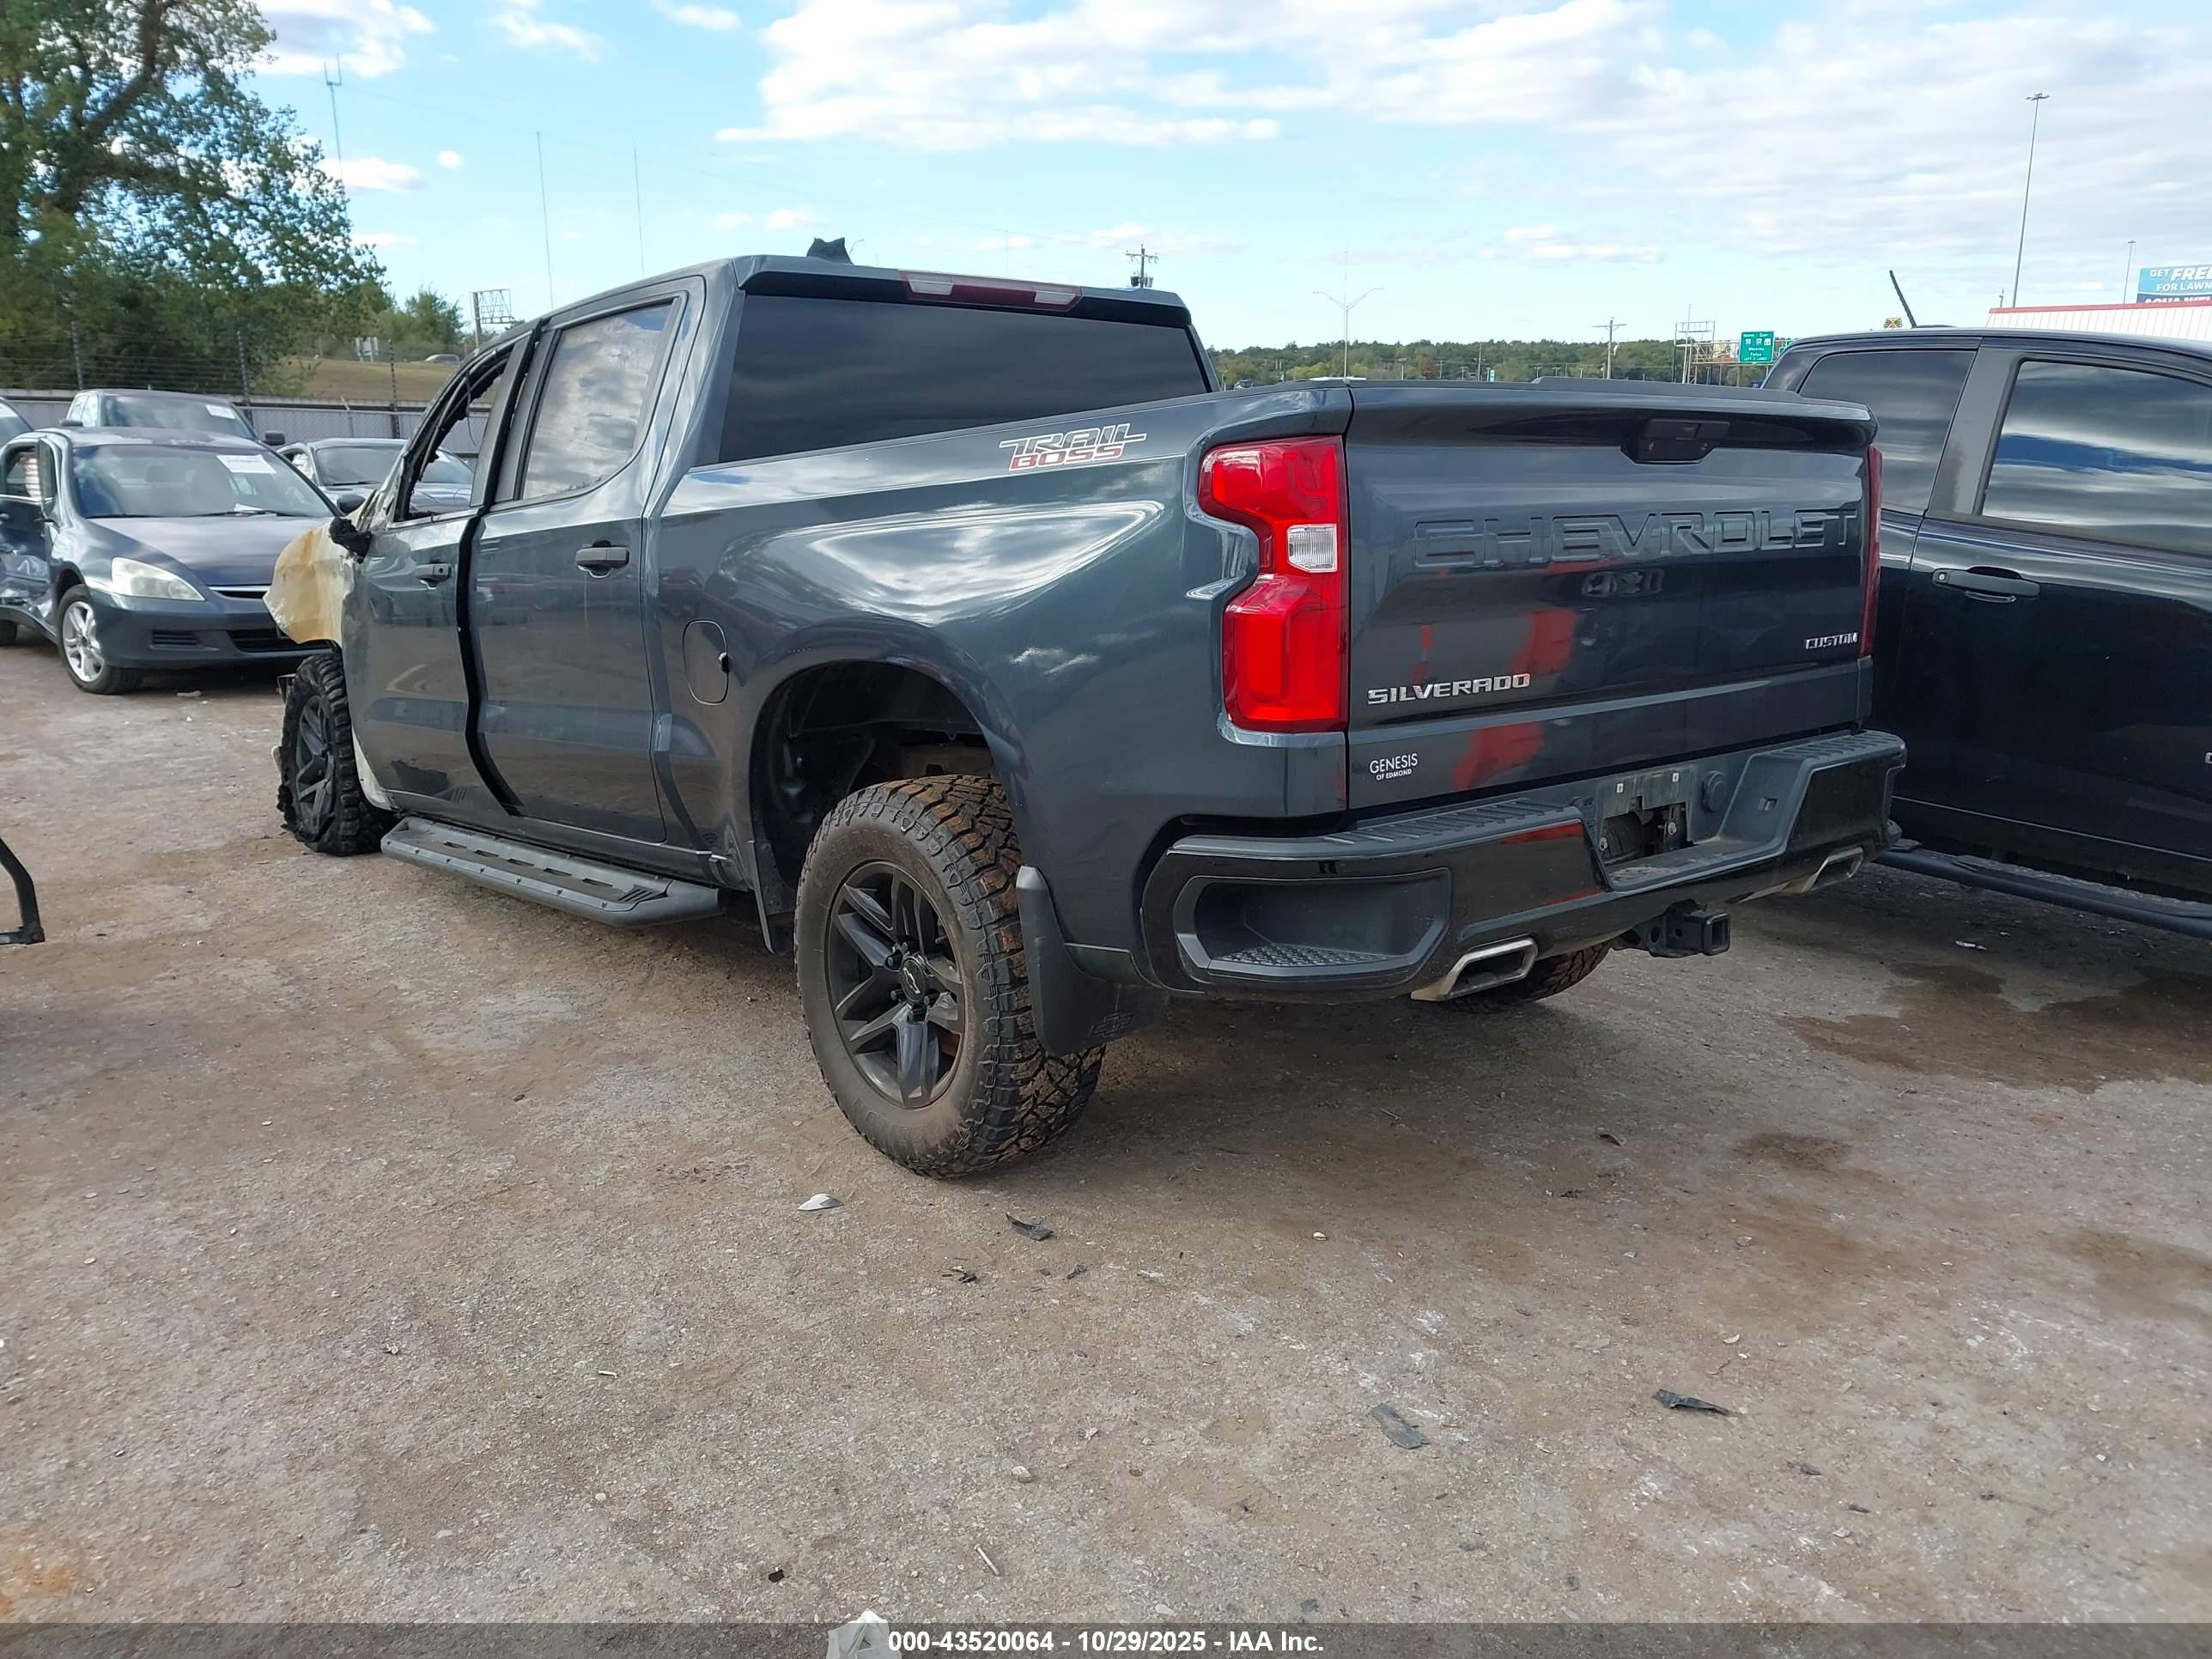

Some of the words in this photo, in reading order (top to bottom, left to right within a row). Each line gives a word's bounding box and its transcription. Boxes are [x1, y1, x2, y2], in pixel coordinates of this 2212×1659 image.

[2149, 269, 2171, 277] GET
[2156, 283, 2179, 291] FOR
[999, 423, 1147, 455] TRAIL
[1009, 443, 1123, 471] BOSS
[1415, 508, 1857, 568] CHEVROLET
[1806, 632, 1858, 649] CUSTOM
[1367, 673, 1531, 705] SILVERADO
[1370, 752, 1418, 774] GENESIS
[1385, 769, 1413, 779] EDMOND
